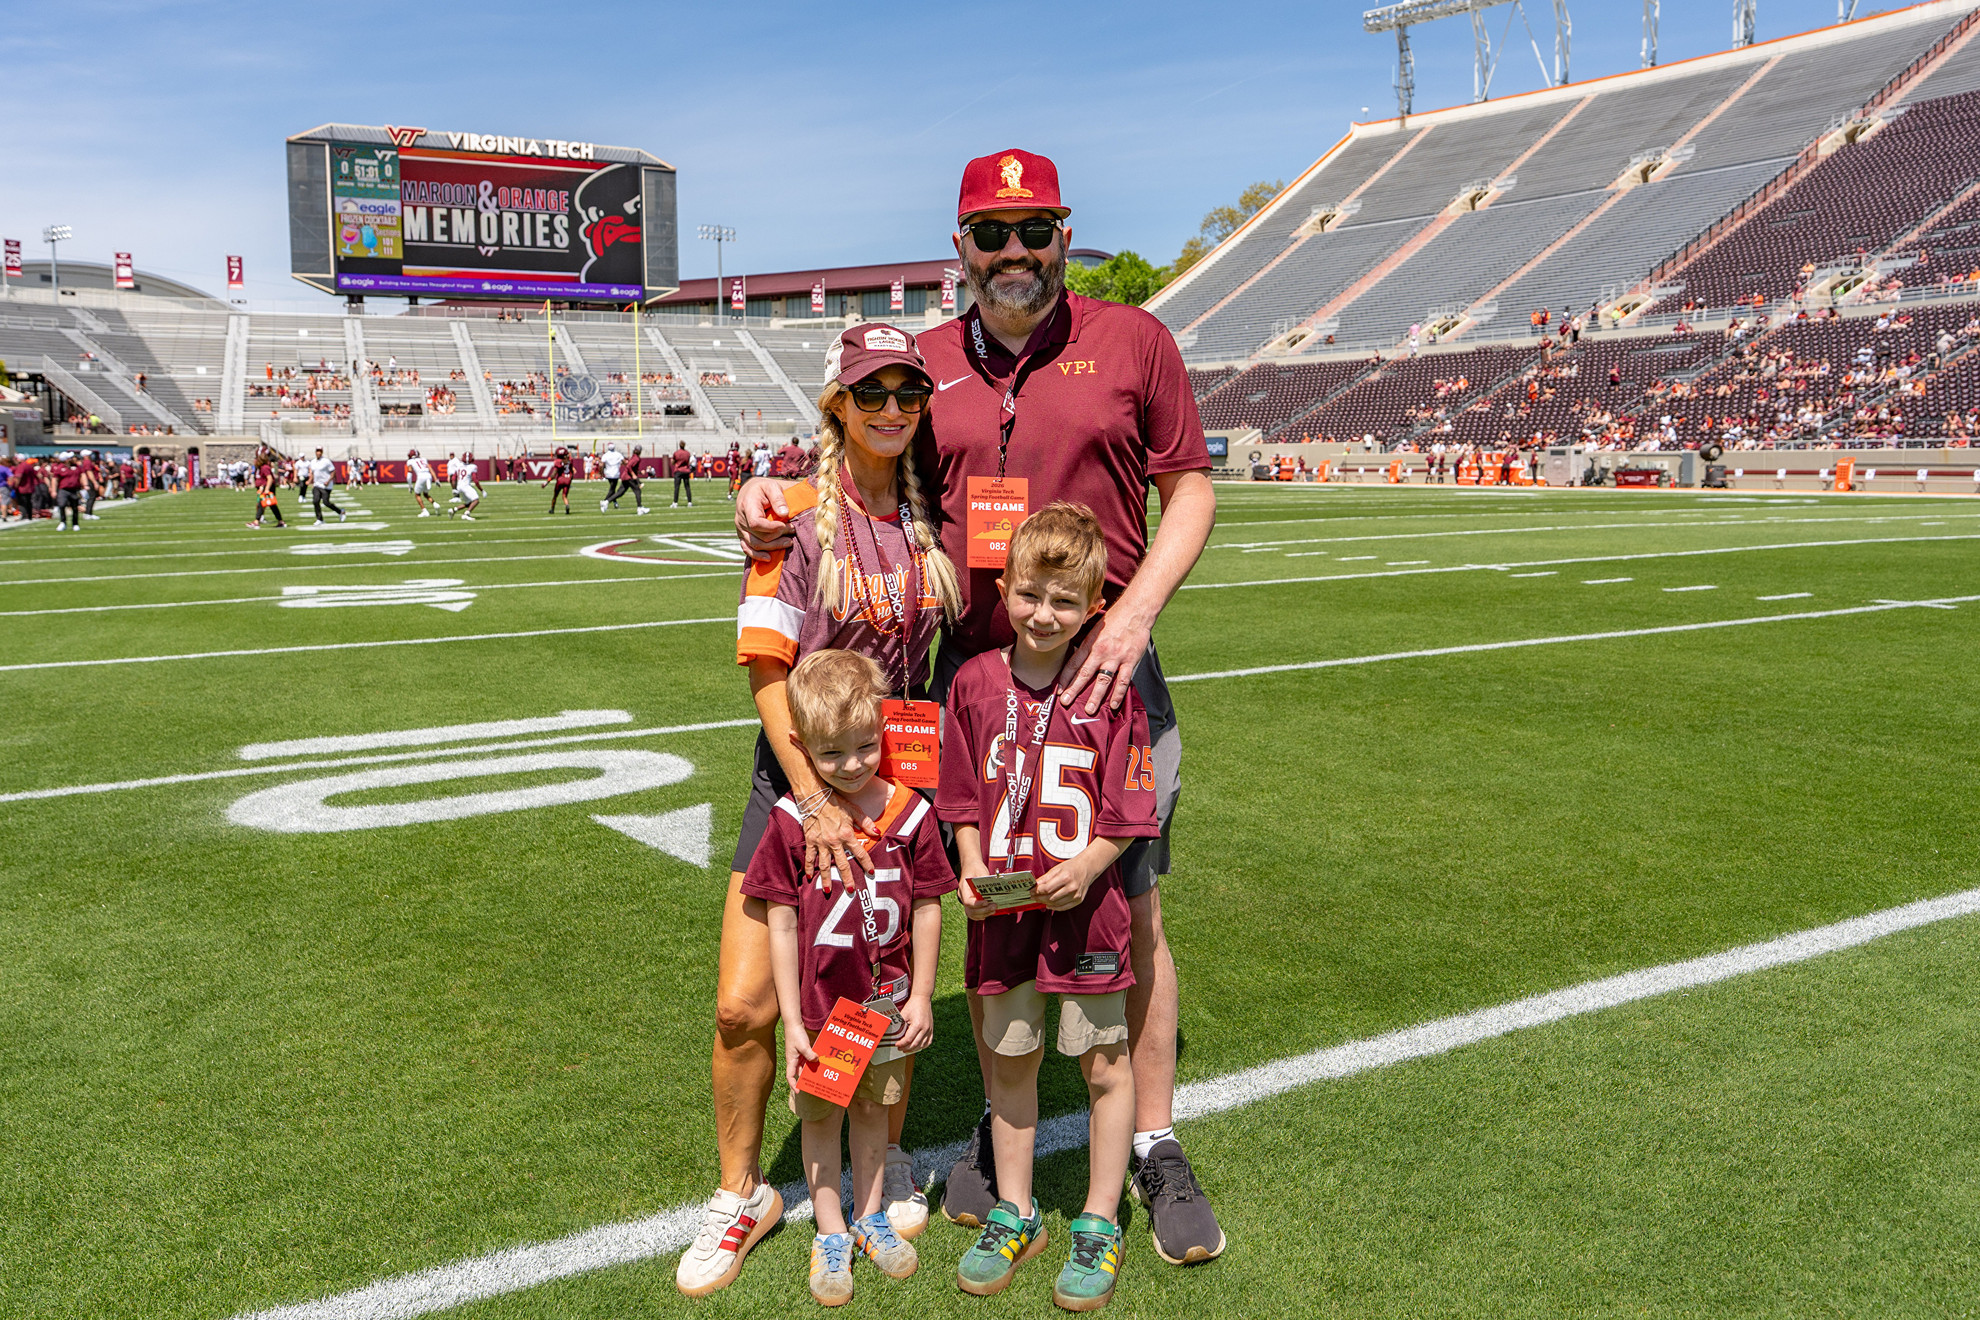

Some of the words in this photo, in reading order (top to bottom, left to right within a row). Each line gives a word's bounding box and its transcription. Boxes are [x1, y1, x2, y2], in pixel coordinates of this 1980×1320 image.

[384, 124, 427, 147] VT
[448, 131, 542, 156] VIRGINIA
[545, 139, 594, 160] TECH
[374, 149, 398, 162] VT
[341, 161, 349, 174] 0
[355, 165, 378, 177] 51:01
[384, 164, 392, 177] 0
[402, 180, 476, 206] MAROON
[477, 180, 499, 215] &
[498, 187, 569, 211] ORANGE
[360, 203, 396, 215] eagle
[403, 206, 570, 248] MEMORIES
[478, 245, 500, 257] VT
[231, 268, 240, 280] 7
[351, 278, 375, 287] eagle
[491, 283, 513, 292] eagle
[620, 288, 639, 297] eagle
[732, 290, 743, 301] 64
[812, 294, 823, 304] 56
[971, 318, 988, 359] HOKIES
[1057, 360, 1096, 376] VPI
[528, 461, 555, 477] VT
[971, 502, 992, 511] PRE
[993, 502, 1025, 512] GAME
[899, 503, 915, 544] HOKIES
[989, 541, 1006, 551] 082
[884, 572, 905, 623] HOKIES
[1005, 688, 1018, 741] HOKIES
[1031, 694, 1054, 745] HOKIES
[884, 724, 903, 733] PRE
[905, 725, 936, 735] GAME
[895, 742, 932, 753] TECH
[900, 762, 918, 771] 085
[1124, 744, 1156, 791] 25
[983, 742, 1099, 862] 25
[979, 881, 1035, 894] MEMORIES
[813, 864, 901, 948] 25
[858, 888, 879, 942] HOKIES
[831, 1016, 847, 1026] Spring
[846, 1021, 866, 1032] Football
[865, 1029, 879, 1038] Game
[844, 1013, 861, 1024] Virginia
[861, 1020, 873, 1028] Tech
[826, 1023, 846, 1038] PRE
[845, 1031, 875, 1049] GAME
[829, 1046, 861, 1066] TECH
[823, 1068, 840, 1082] 083
